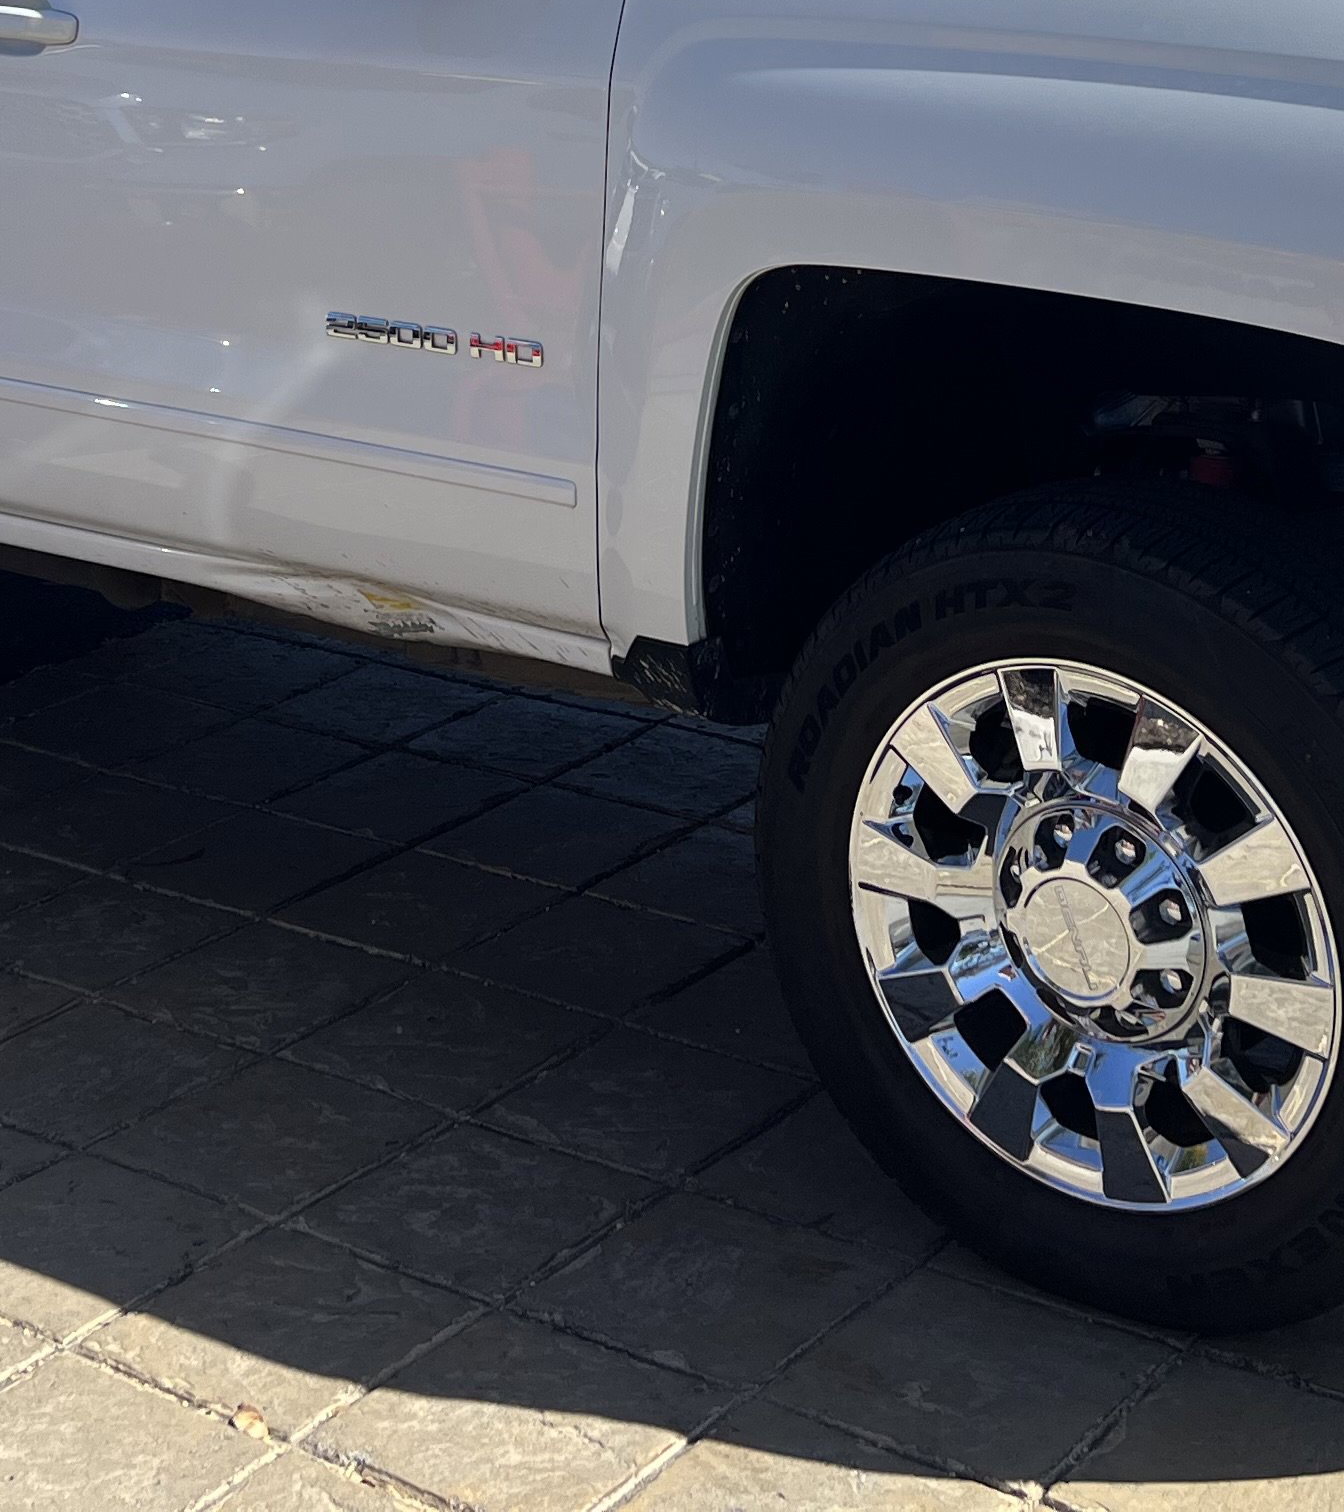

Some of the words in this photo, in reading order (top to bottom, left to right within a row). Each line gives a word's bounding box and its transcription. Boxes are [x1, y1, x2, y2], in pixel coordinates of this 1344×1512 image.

[325, 311, 458, 356] 2500
[469, 331, 545, 368] HD
[788, 598, 923, 794] ROADIAN
[935, 578, 1077, 621] HTX2
